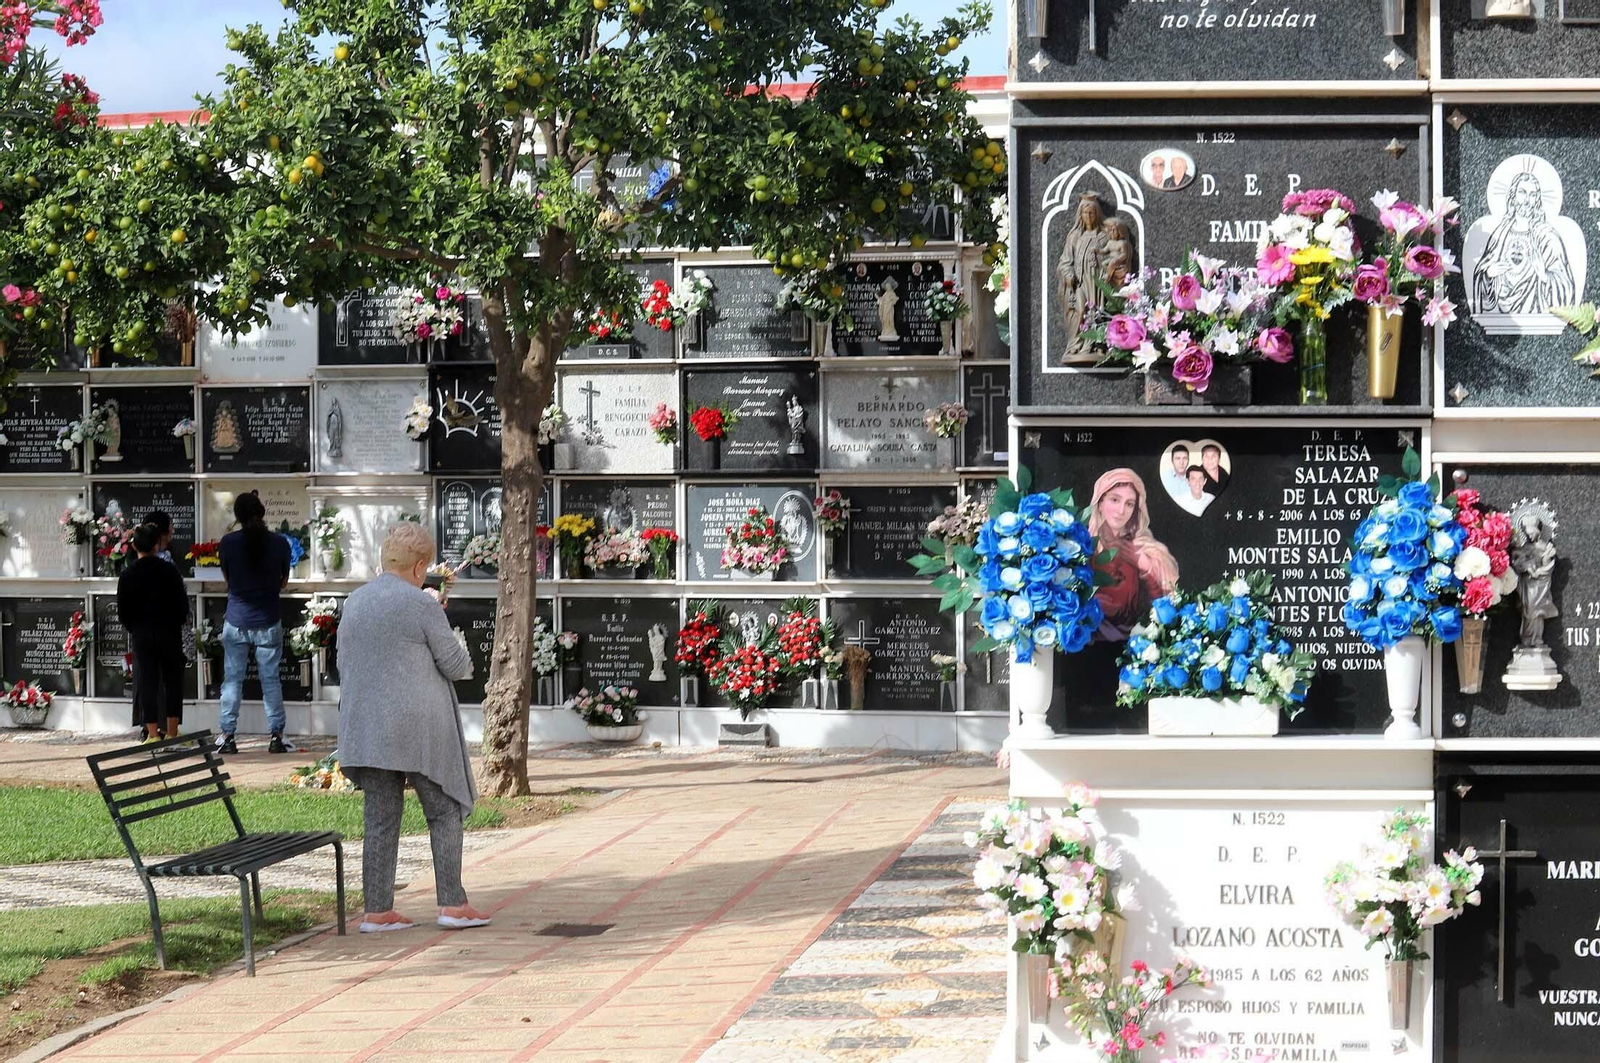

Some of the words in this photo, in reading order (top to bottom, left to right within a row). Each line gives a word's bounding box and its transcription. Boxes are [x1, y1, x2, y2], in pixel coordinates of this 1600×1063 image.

[1160, 13, 1189, 28] no
[1195, 7, 1217, 28] te
[1224, 7, 1317, 28] olvidan
[1196, 133, 1208, 143] N.
[1212, 133, 1236, 143] 1522
[1201, 174, 1220, 196] D.
[1245, 174, 1263, 196] E.
[615, 398, 647, 408] FAMILIA
[857, 402, 926, 413] BERNARDO
[4, 418, 19, 426] JUAN
[20, 418, 43, 426] RIVERA
[45, 418, 68, 426] MACIAS
[836, 418, 882, 428] PELAYO
[615, 428, 647, 436] CARAZO
[1311, 430, 1323, 441] D.
[1333, 430, 1344, 441] E.
[1355, 430, 1365, 441] P.
[1063, 433, 1074, 443] N.
[1076, 433, 1093, 443] 1522
[829, 443, 873, 453] CATALINA
[877, 443, 906, 452] SOUSA
[1302, 444, 1371, 462] TERESA
[1294, 467, 1380, 484] SALAZAR
[725, 498, 744, 506] MORA
[1282, 488, 1305, 505] DE
[1313, 488, 1337, 505] LA
[1344, 488, 1385, 505] CRUZ
[700, 513, 724, 521] JOSEFA
[1236, 510, 1243, 521] 8
[1257, 510, 1264, 521] 8
[1279, 510, 1303, 521] 2006
[1308, 510, 1317, 521] A
[1323, 510, 1345, 521] LOS
[1349, 510, 1361, 521] 65
[853, 522, 884, 531] MANUEL
[886, 522, 915, 531] MILLAN
[1276, 528, 1342, 546] EMILIO
[1228, 548, 1302, 565] MONTES
[1307, 548, 1353, 565] SALA
[1282, 569, 1304, 580] 1990
[1310, 569, 1318, 580] A
[1324, 569, 1346, 580] LOS
[1271, 585, 1350, 603] ANTONIO
[889, 619, 927, 627] ANTONIO
[874, 626, 906, 635] GARCIA
[908, 626, 941, 635] GALVEZ
[1308, 626, 1317, 637] A
[1323, 626, 1345, 638] LOS
[1565, 627, 1590, 646] TUS
[35, 643, 57, 651] JOSEFA
[886, 642, 930, 650] MERCEDES
[1335, 642, 1377, 654] NIETOS
[874, 649, 906, 658] GARCIA
[889, 664, 926, 673] MANUEL
[1322, 658, 1337, 670] OS
[1342, 658, 1386, 670] OLVIDA
[874, 672, 911, 681] BARRIOS
[914, 670, 941, 681] YAÑEZ
[1232, 812, 1246, 825] N.
[1252, 812, 1286, 826] 1522
[1218, 846, 1232, 862] D.
[1253, 846, 1268, 862] E.
[1287, 846, 1301, 862] P.
[1219, 884, 1295, 905] ELVIRA
[1172, 926, 1256, 948] LOZANO
[1265, 927, 1344, 948] ACOSTA
[1209, 968, 1243, 982] 1985
[1251, 968, 1260, 981] A
[1269, 968, 1296, 982] LOS
[1304, 968, 1323, 982] 62
[1332, 964, 1370, 982] AÑOS
[1178, 1000, 1232, 1013] ESPOSO
[1241, 1001, 1281, 1014] HIJOS
[1289, 1002, 1299, 1014] Y
[1307, 1002, 1365, 1015] FAMILIA
[1197, 1031, 1218, 1044] NO
[1228, 1032, 1245, 1044] TE
[1254, 1032, 1315, 1045] OLVIDAN
[1271, 1048, 1338, 1061] FAMILIA
